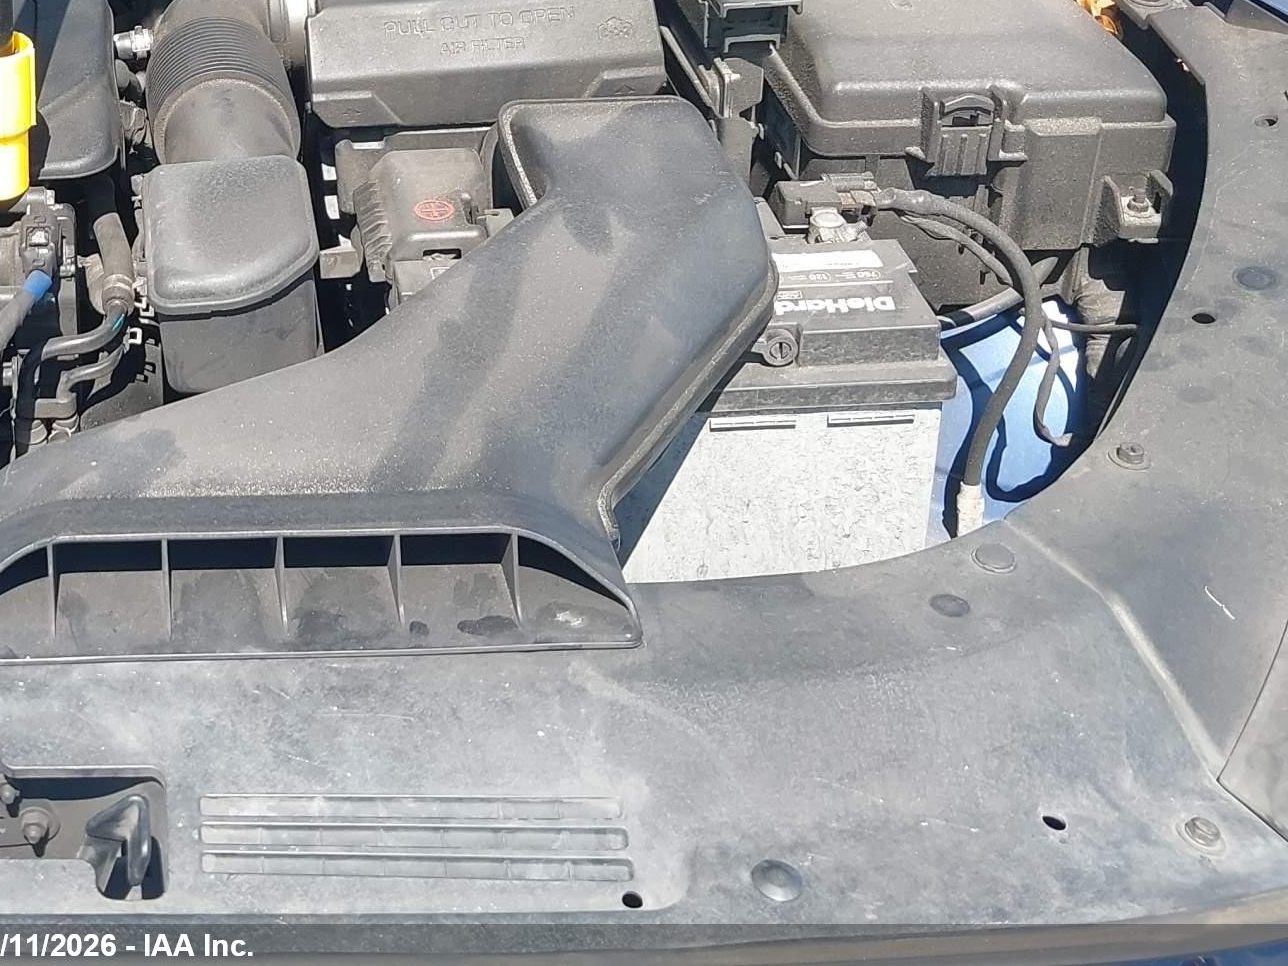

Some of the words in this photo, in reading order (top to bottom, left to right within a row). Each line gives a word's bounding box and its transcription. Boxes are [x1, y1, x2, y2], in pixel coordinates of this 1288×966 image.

[383, 19, 435, 37] PULL
[441, 15, 480, 32] OUT
[487, 11, 514, 27] TO
[519, 6, 575, 24] OPEN
[440, 40, 466, 55] AIR
[472, 37, 526, 52] FILTER
[775, 296, 895, 315] DieHard
